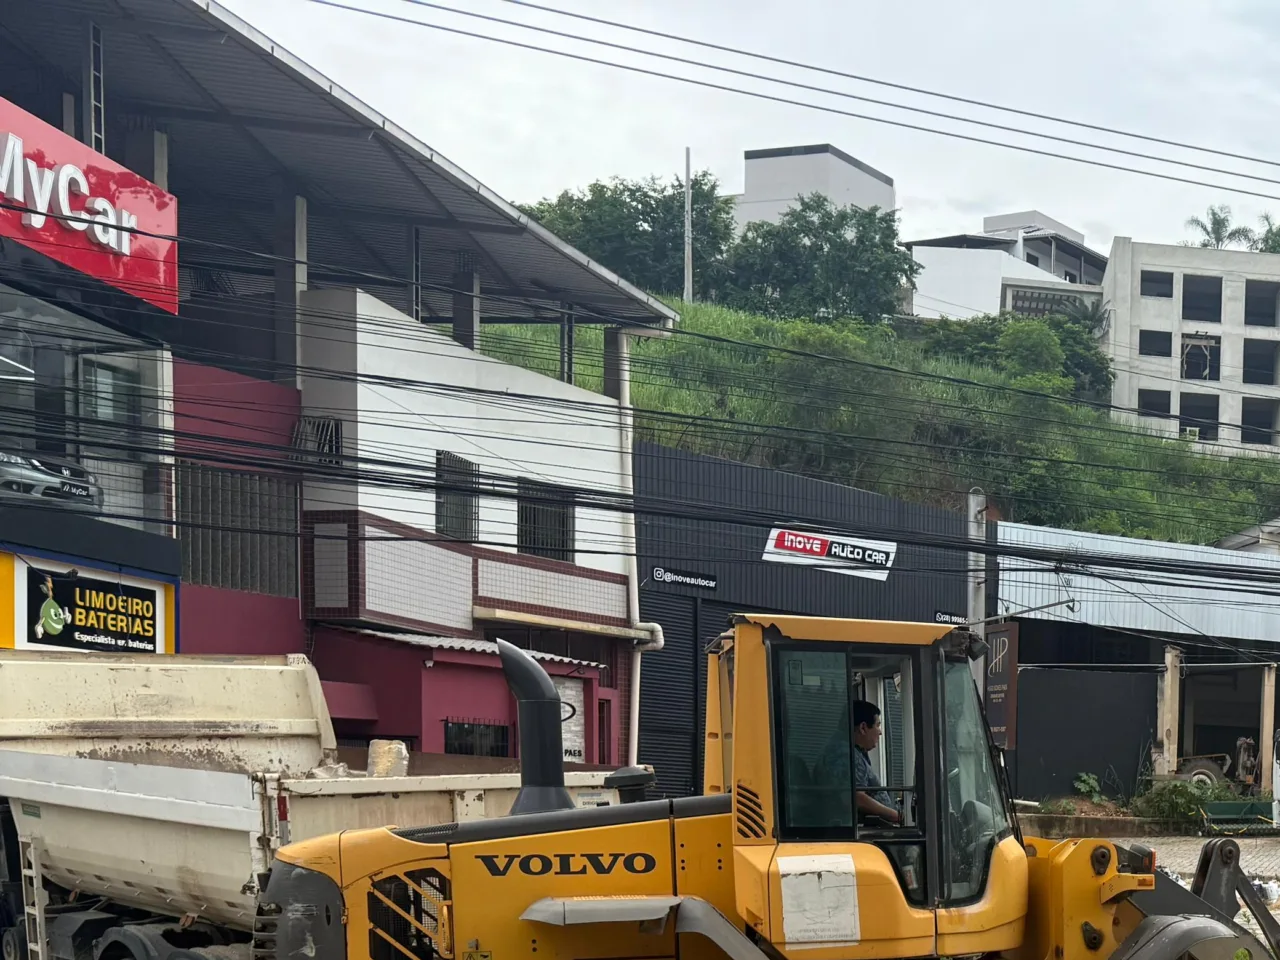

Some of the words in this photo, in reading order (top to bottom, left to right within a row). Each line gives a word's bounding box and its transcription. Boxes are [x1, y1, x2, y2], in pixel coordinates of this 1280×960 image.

[0, 132, 138, 256] MyCar
[865, 550, 886, 564] CAR
[664, 572, 717, 587] @inoveautocar
[75, 587, 153, 618] LIMOEIRO
[74, 608, 154, 637] BATERIAS
[74, 632, 116, 645] Especialista
[128, 639, 154, 650] baterias
[564, 748, 583, 757] PAES
[475, 852, 657, 877] VOLVO
